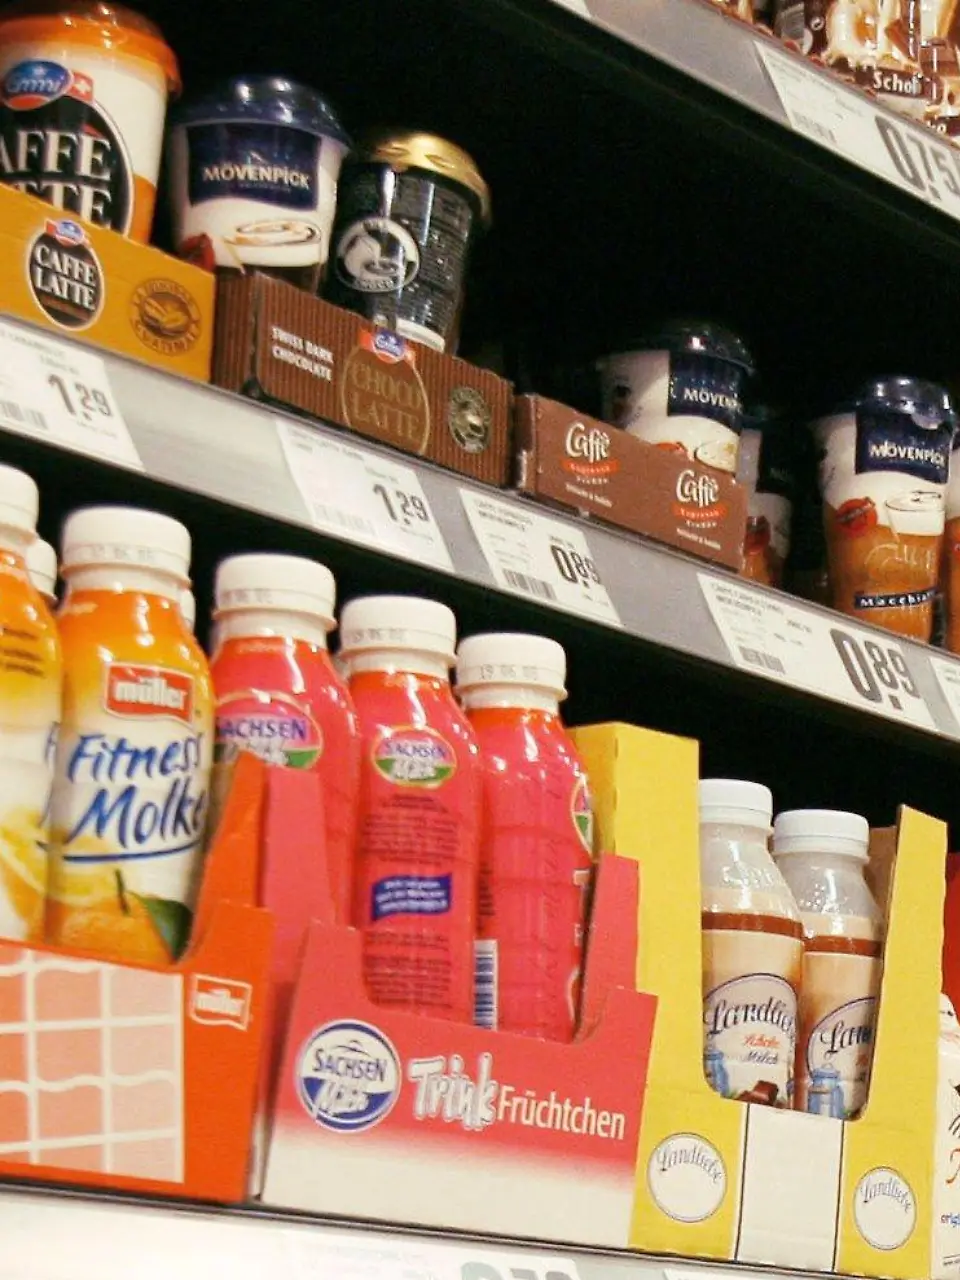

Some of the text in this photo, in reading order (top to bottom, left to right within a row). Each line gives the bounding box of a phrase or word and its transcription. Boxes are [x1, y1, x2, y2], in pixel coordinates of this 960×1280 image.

[203, 160, 311, 191] MÖVENPICK
[35, 243, 97, 286] CAFFE
[34, 270, 96, 310] LATTE
[829, 627, 921, 710] 0.89
[215, 718, 307, 742] ACHSEN
[312, 1047, 388, 1082] SACHSEN
[408, 1052, 626, 1141] Trink Früchtchen
